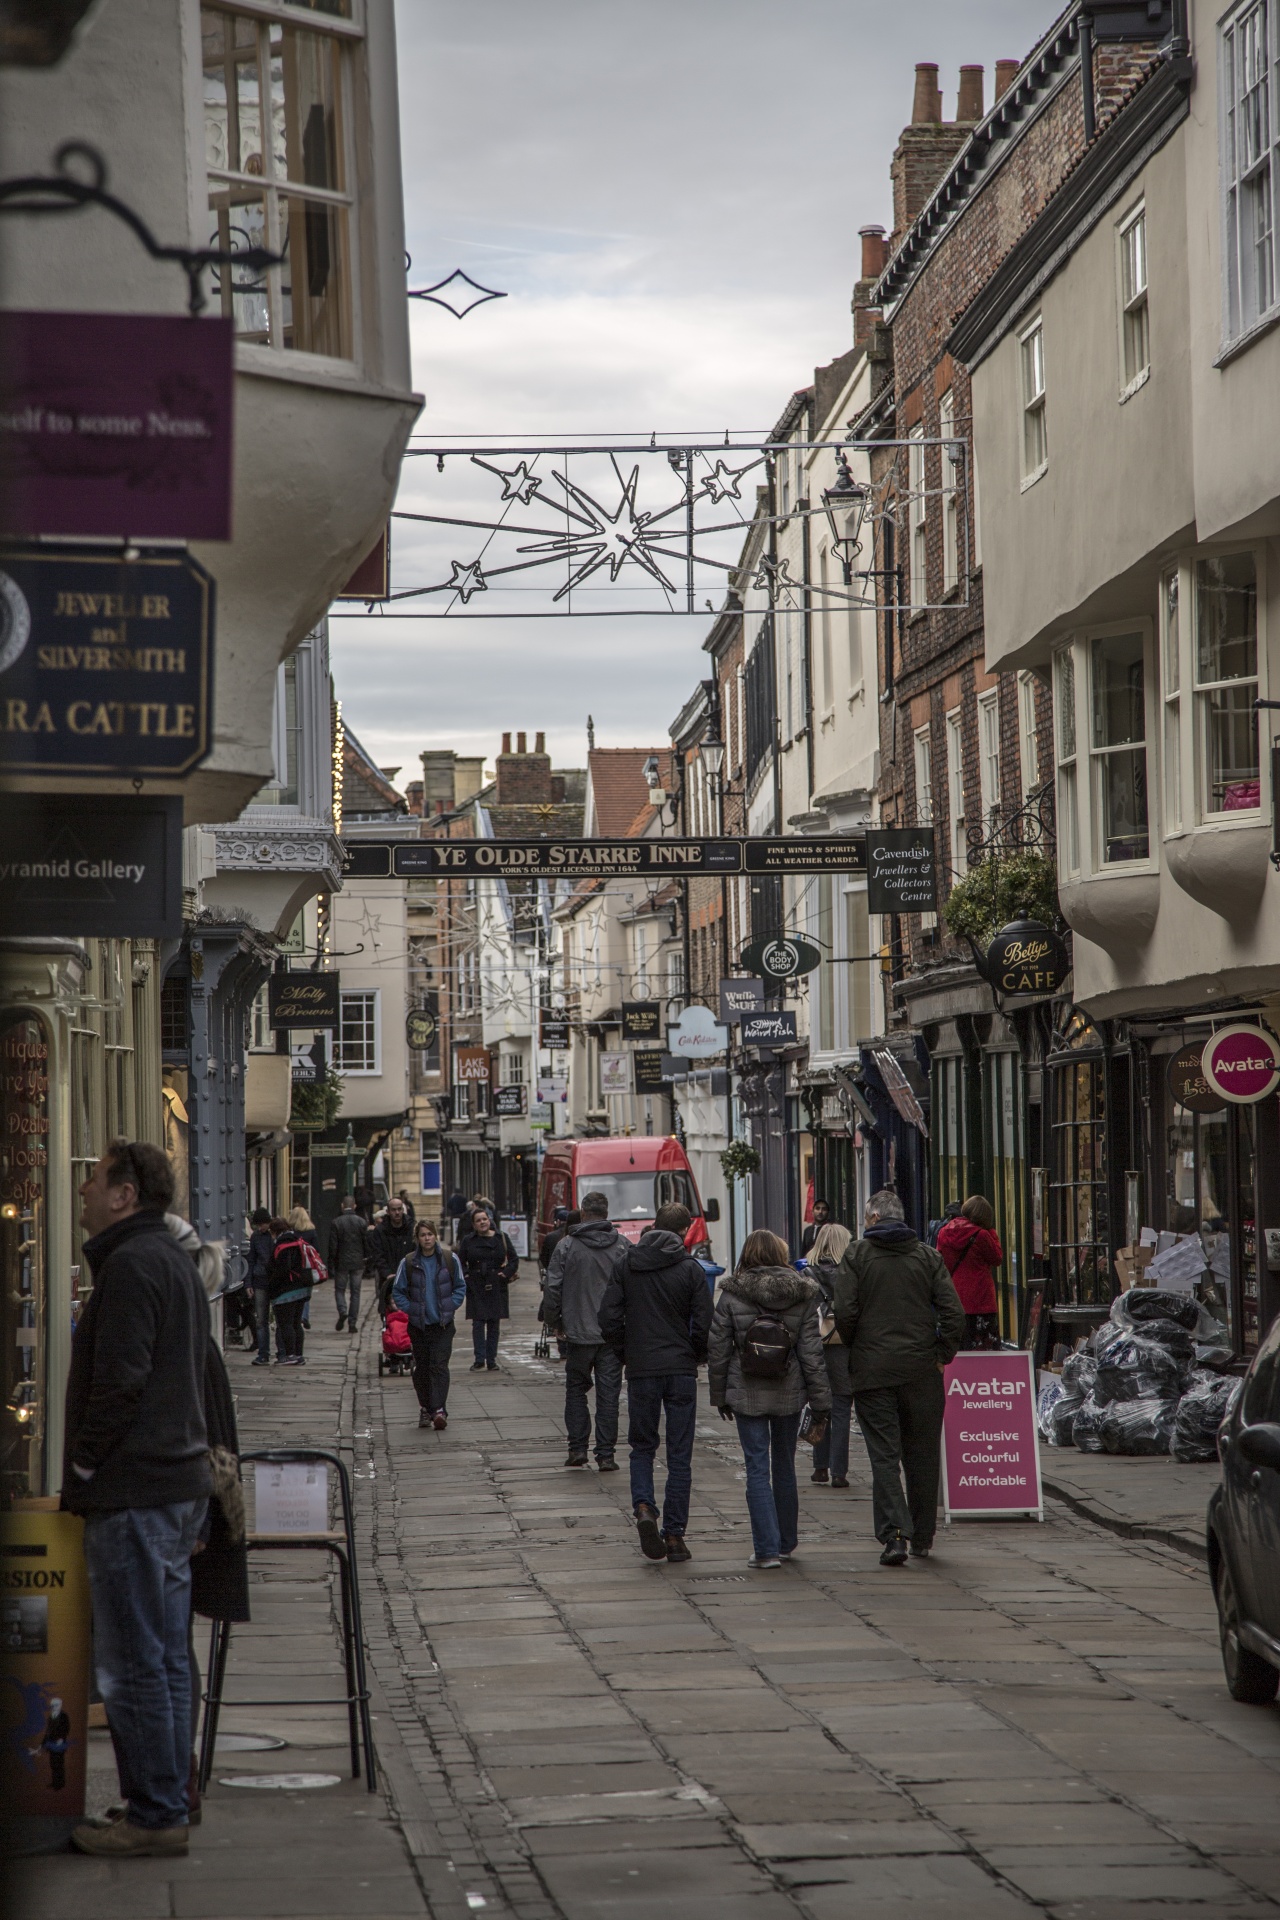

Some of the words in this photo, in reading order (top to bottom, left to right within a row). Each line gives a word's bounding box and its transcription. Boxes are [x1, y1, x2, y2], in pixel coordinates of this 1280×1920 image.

[91, 620, 126, 643] and
[38, 645, 187, 673] SILVERSMITH
[66, 701, 195, 738] CATTLE
[475, 847, 541, 866] OLDE
[549, 845, 642, 865] STARRE
[649, 844, 702, 863] INNE
[872, 847, 931, 860] Cavendish
[74, 859, 145, 883] Gallery
[873, 865, 918, 878] Jewellers
[920, 864, 930, 874] &
[884, 878, 931, 888] Collectors
[900, 892, 932, 901] Centre
[1003, 941, 1050, 966] Bettys
[1002, 971, 1056, 989] CAFE
[281, 986, 327, 1003] Molly
[275, 1003, 334, 1017] Browns
[744, 1025, 771, 1037] weird
[773, 1023, 794, 1038] fish
[459, 1057, 484, 1068] LAKE
[1214, 1057, 1271, 1073] Avatar
[459, 1067, 489, 1078] LAND
[947, 1378, 1026, 1396] Avatar
[962, 1399, 1012, 1411] Jewellery
[959, 1431, 1019, 1441] Exclusive
[962, 1452, 1020, 1463] Colourful
[959, 1475, 1026, 1486] Affordable
